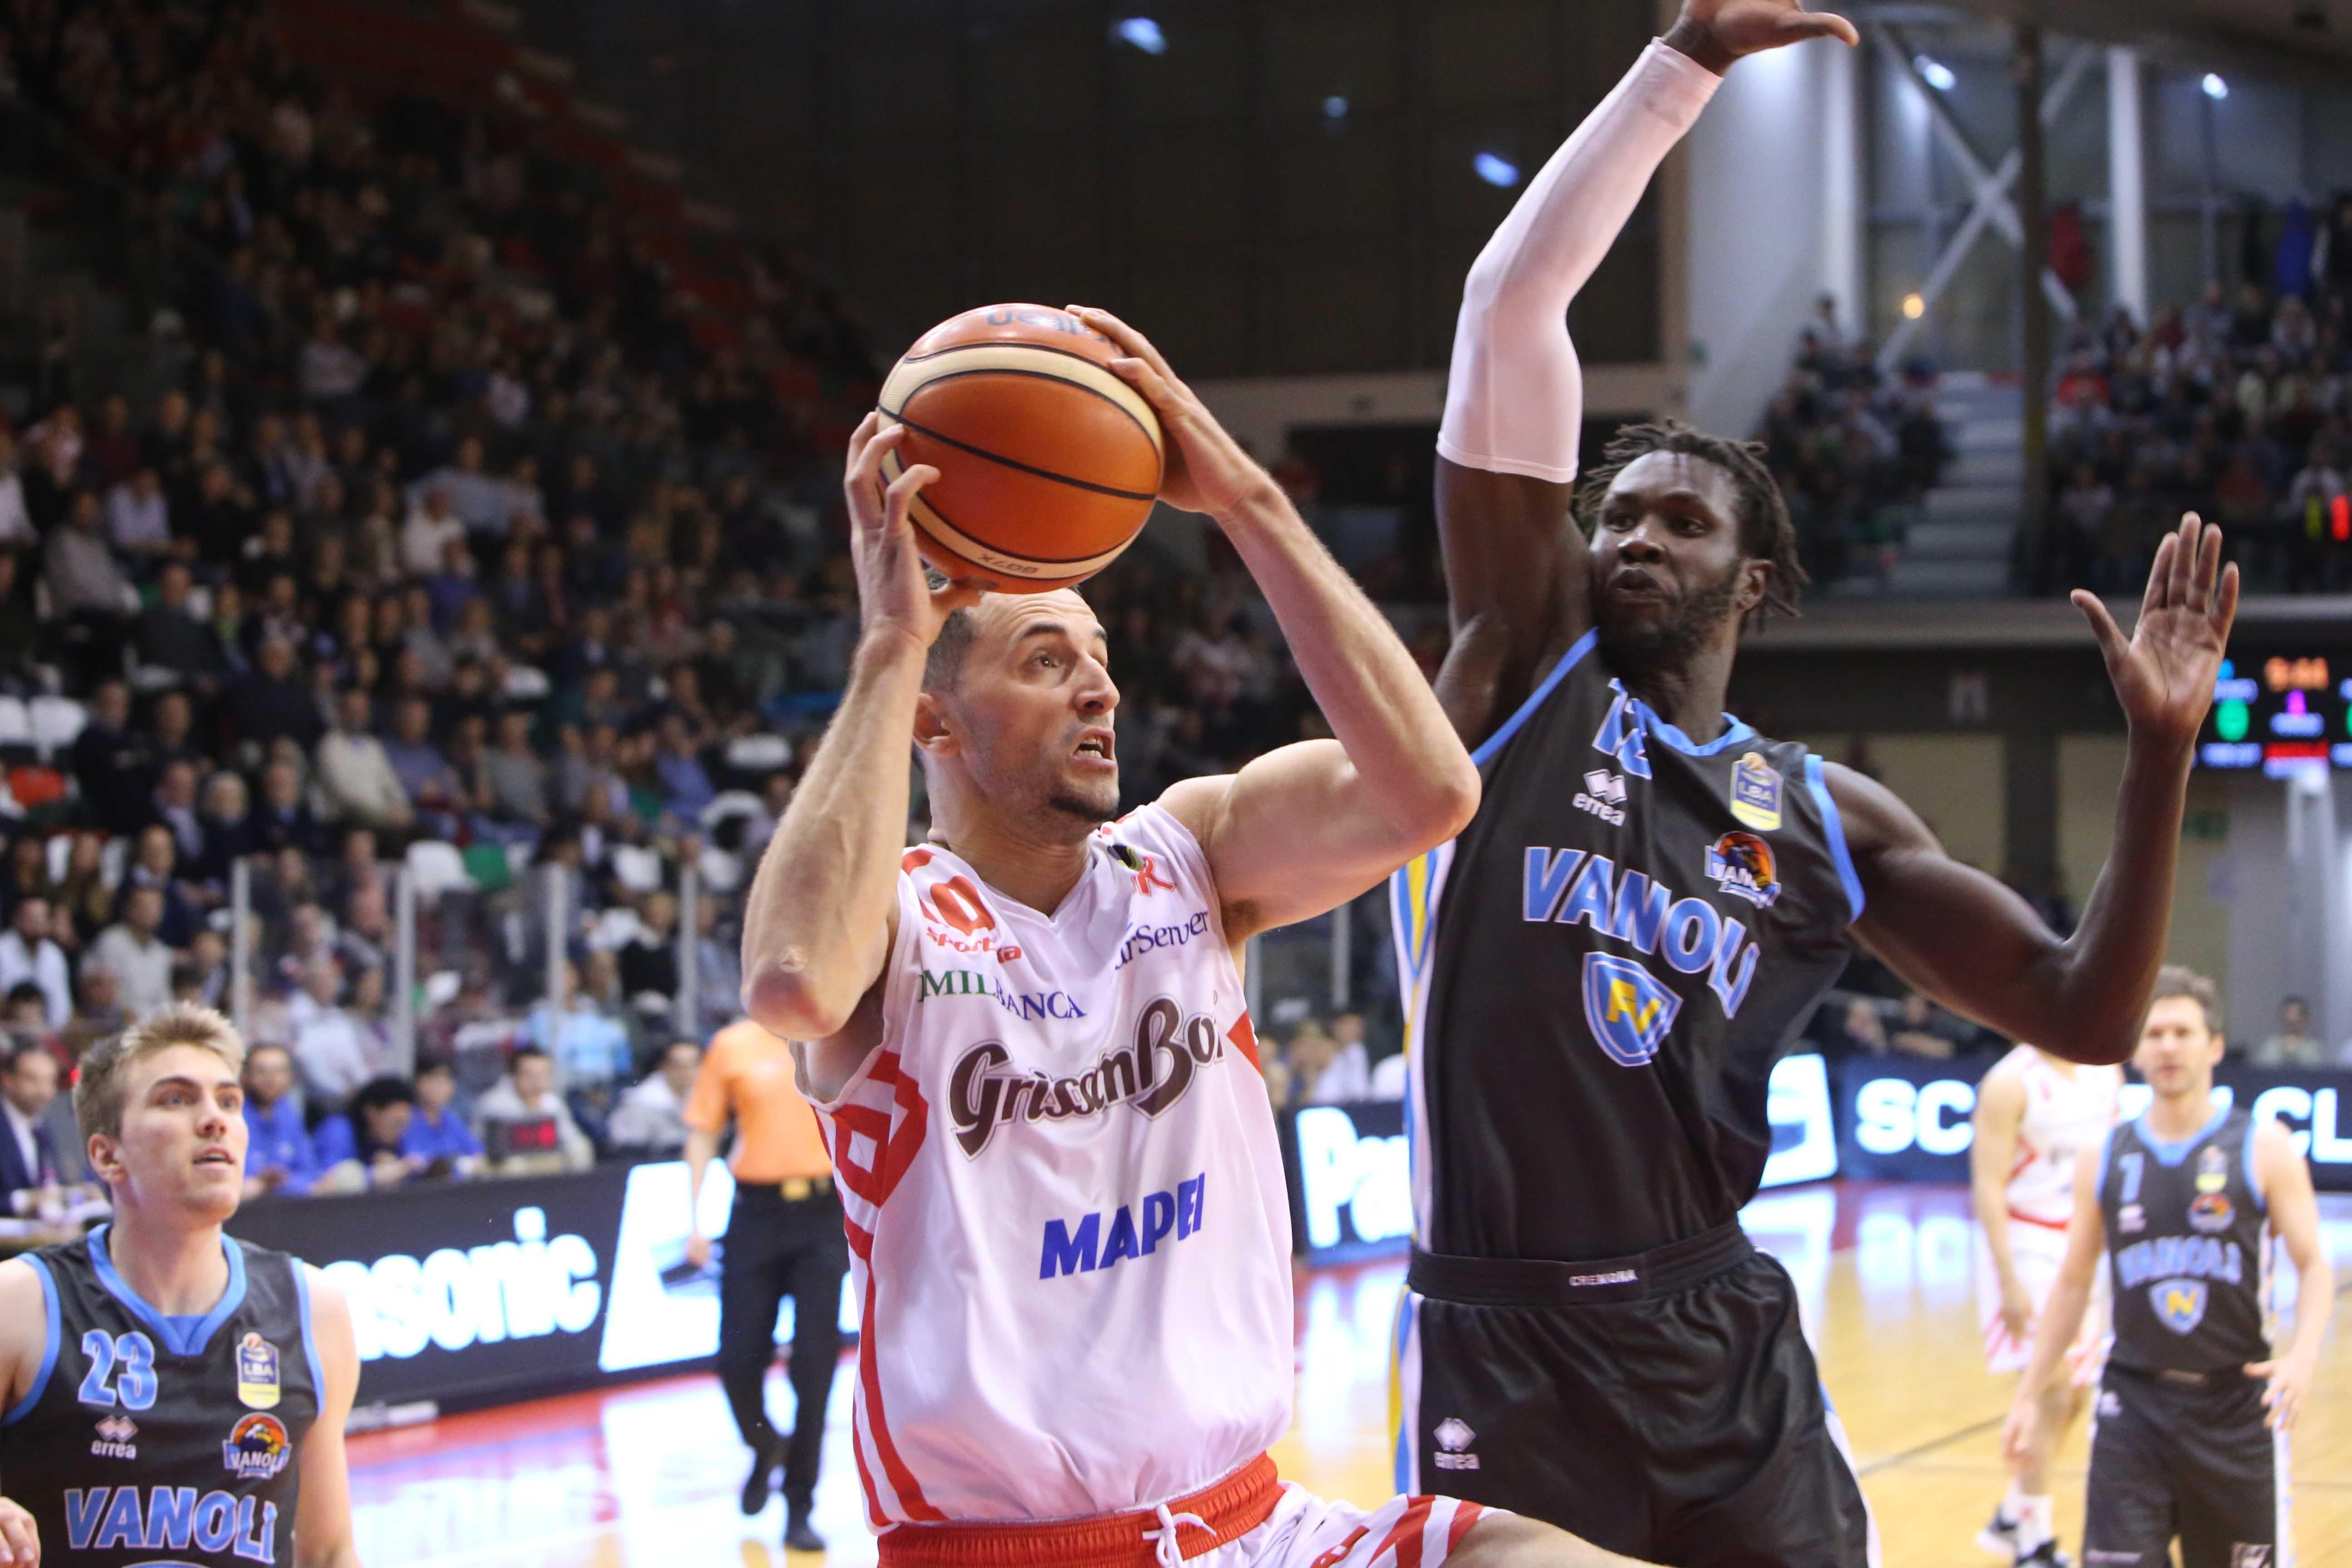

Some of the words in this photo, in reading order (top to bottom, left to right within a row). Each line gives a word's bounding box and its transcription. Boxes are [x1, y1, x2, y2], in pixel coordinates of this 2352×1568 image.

[1523, 846, 1761, 1019] VANOLI
[1039, 1172, 1205, 1279] MAPEI
[78, 1329, 158, 1410] 23
[230, 1451, 284, 1473] VANOLI
[64, 1486, 276, 1564] VANOLI
